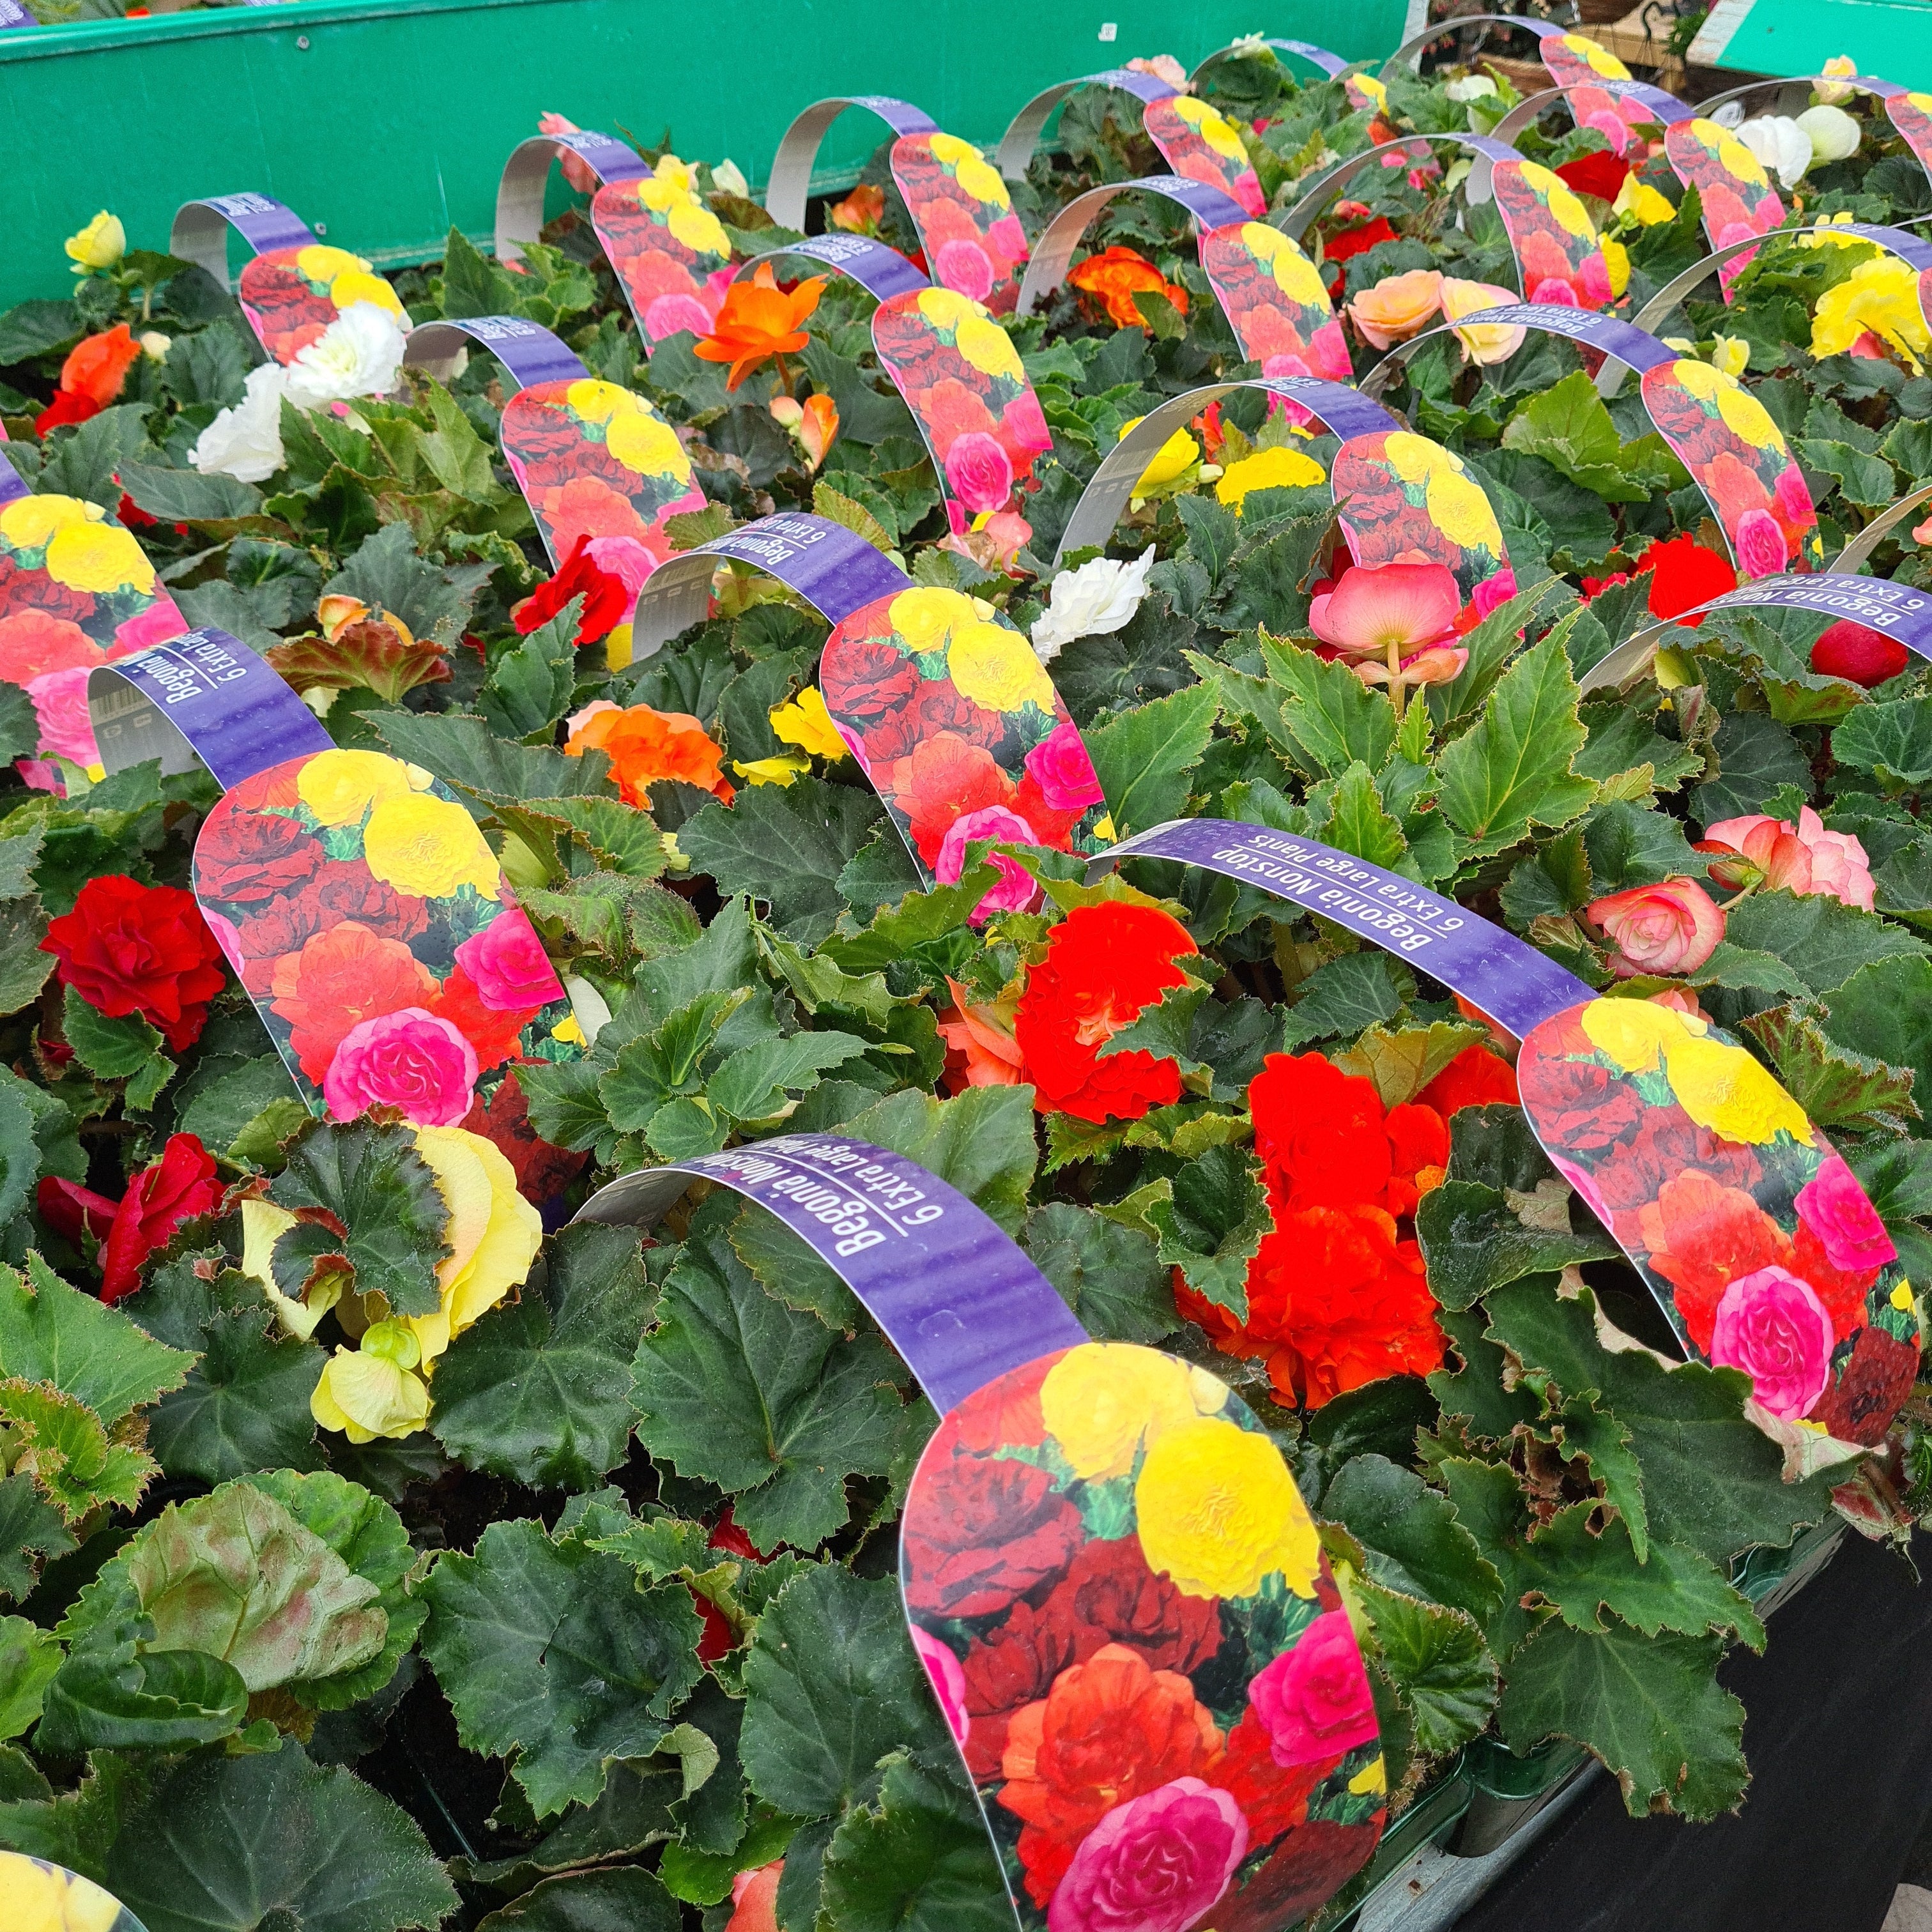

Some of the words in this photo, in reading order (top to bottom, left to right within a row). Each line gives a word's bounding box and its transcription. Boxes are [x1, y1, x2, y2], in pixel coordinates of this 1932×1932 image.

[729, 537, 795, 565] Begonia
[802, 531, 827, 544] 6
[1770, 576, 1836, 588] Large
[1836, 580, 1905, 602] Extra
[1784, 591, 1902, 627] Begonia
[1901, 599, 1925, 610] 6
[194, 643, 238, 673] Extra
[132, 655, 203, 704] Begonia
[216, 667, 248, 682] 6
[1248, 834, 1319, 862] Plants
[1211, 847, 1322, 894] Nonstop
[1315, 857, 1381, 889] Large
[1377, 884, 1445, 921] Extra
[1318, 889, 1434, 951] Begonia
[1436, 917, 1464, 931] 6
[804, 1144, 869, 1173] Large
[854, 1164, 926, 1210] Extra
[770, 1175, 887, 1257] Begonia
[901, 1205, 944, 1225] 6
